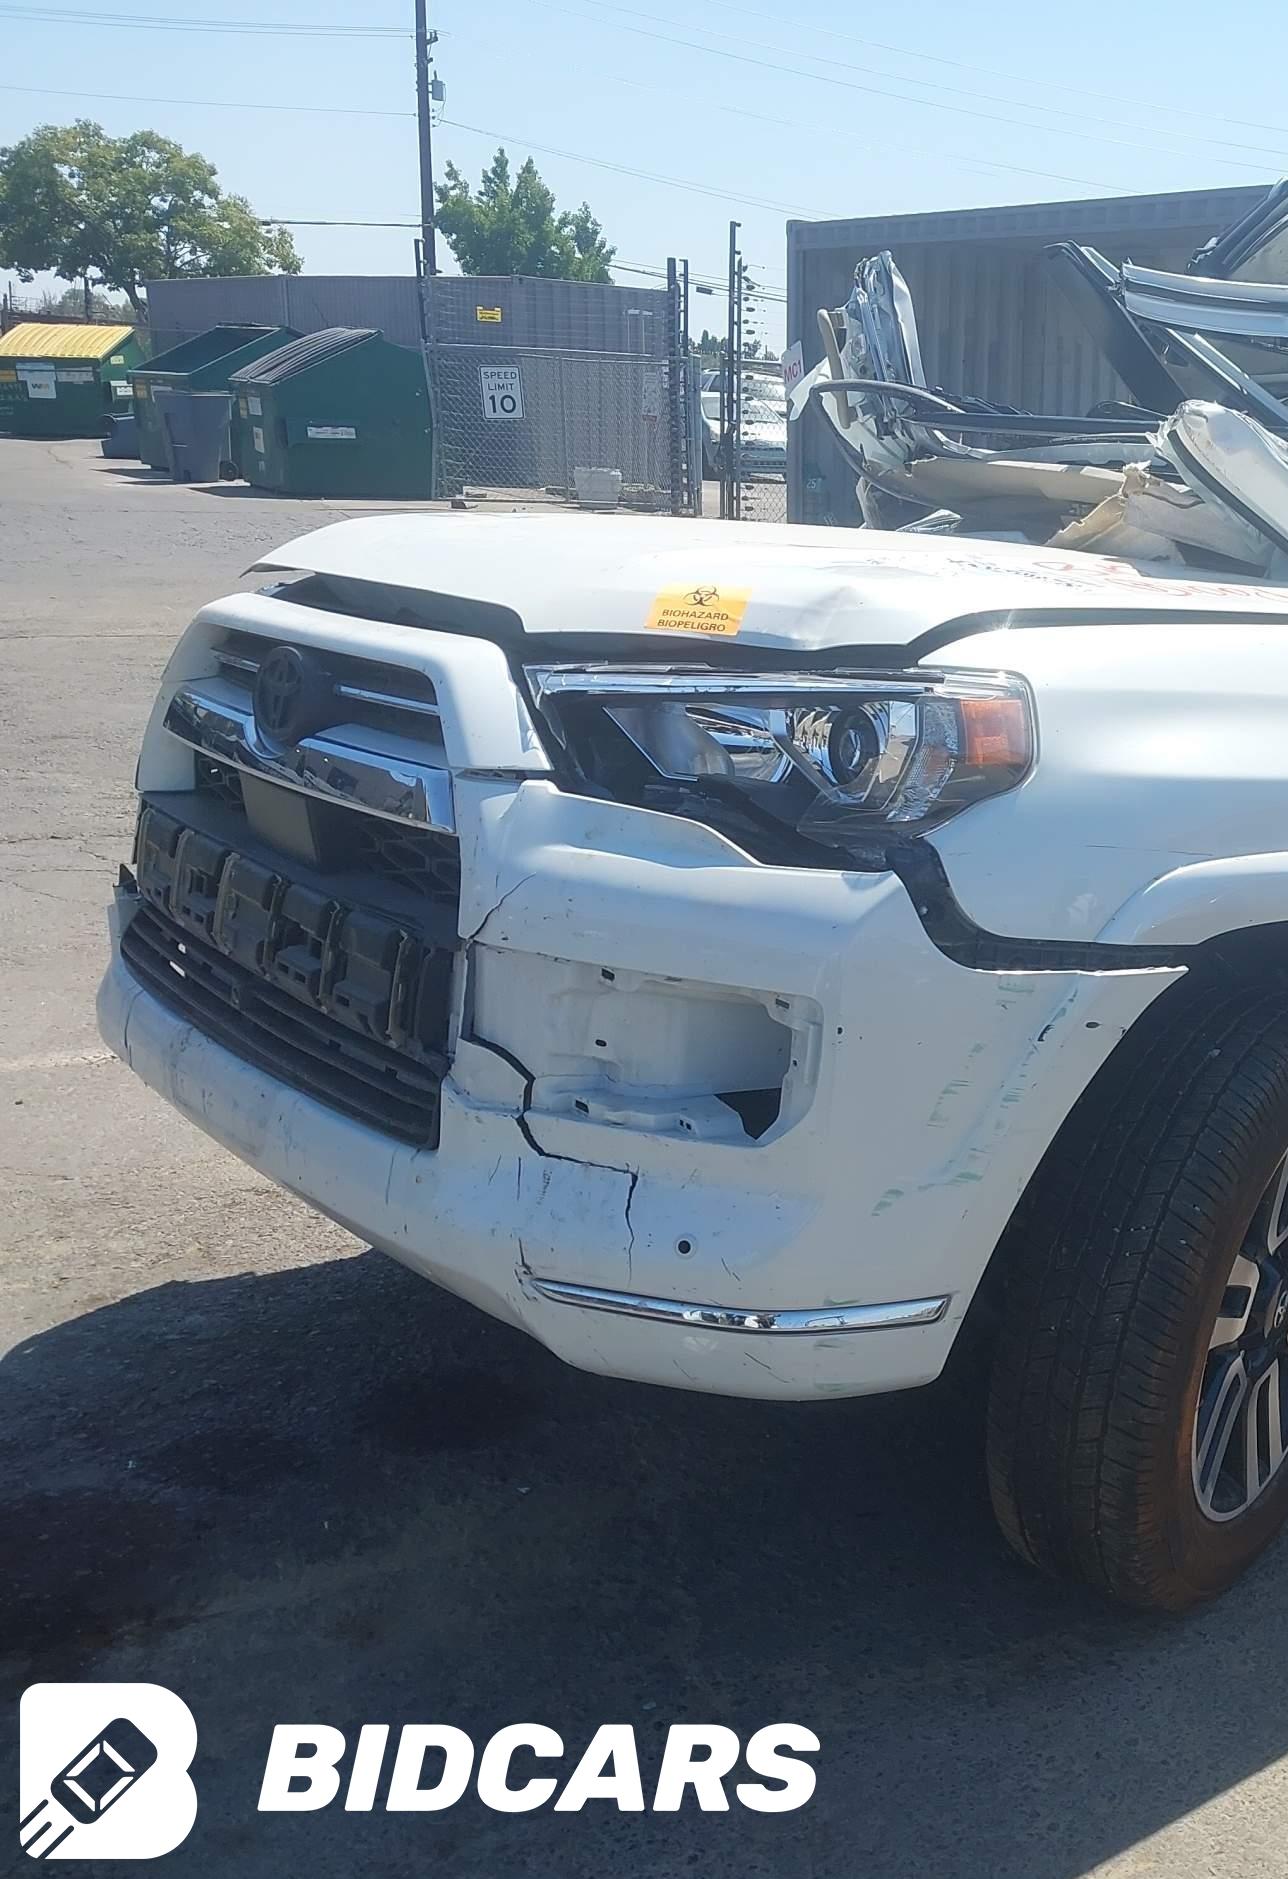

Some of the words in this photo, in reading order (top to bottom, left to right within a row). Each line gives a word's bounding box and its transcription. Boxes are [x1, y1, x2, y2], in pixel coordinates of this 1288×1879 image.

[483, 371, 517, 380] SPEED
[488, 383, 515, 391] LIMIT
[488, 394, 517, 414] 10
[662, 608, 729, 621] BIOHAZARD
[657, 619, 726, 632] BIOPELIGRO
